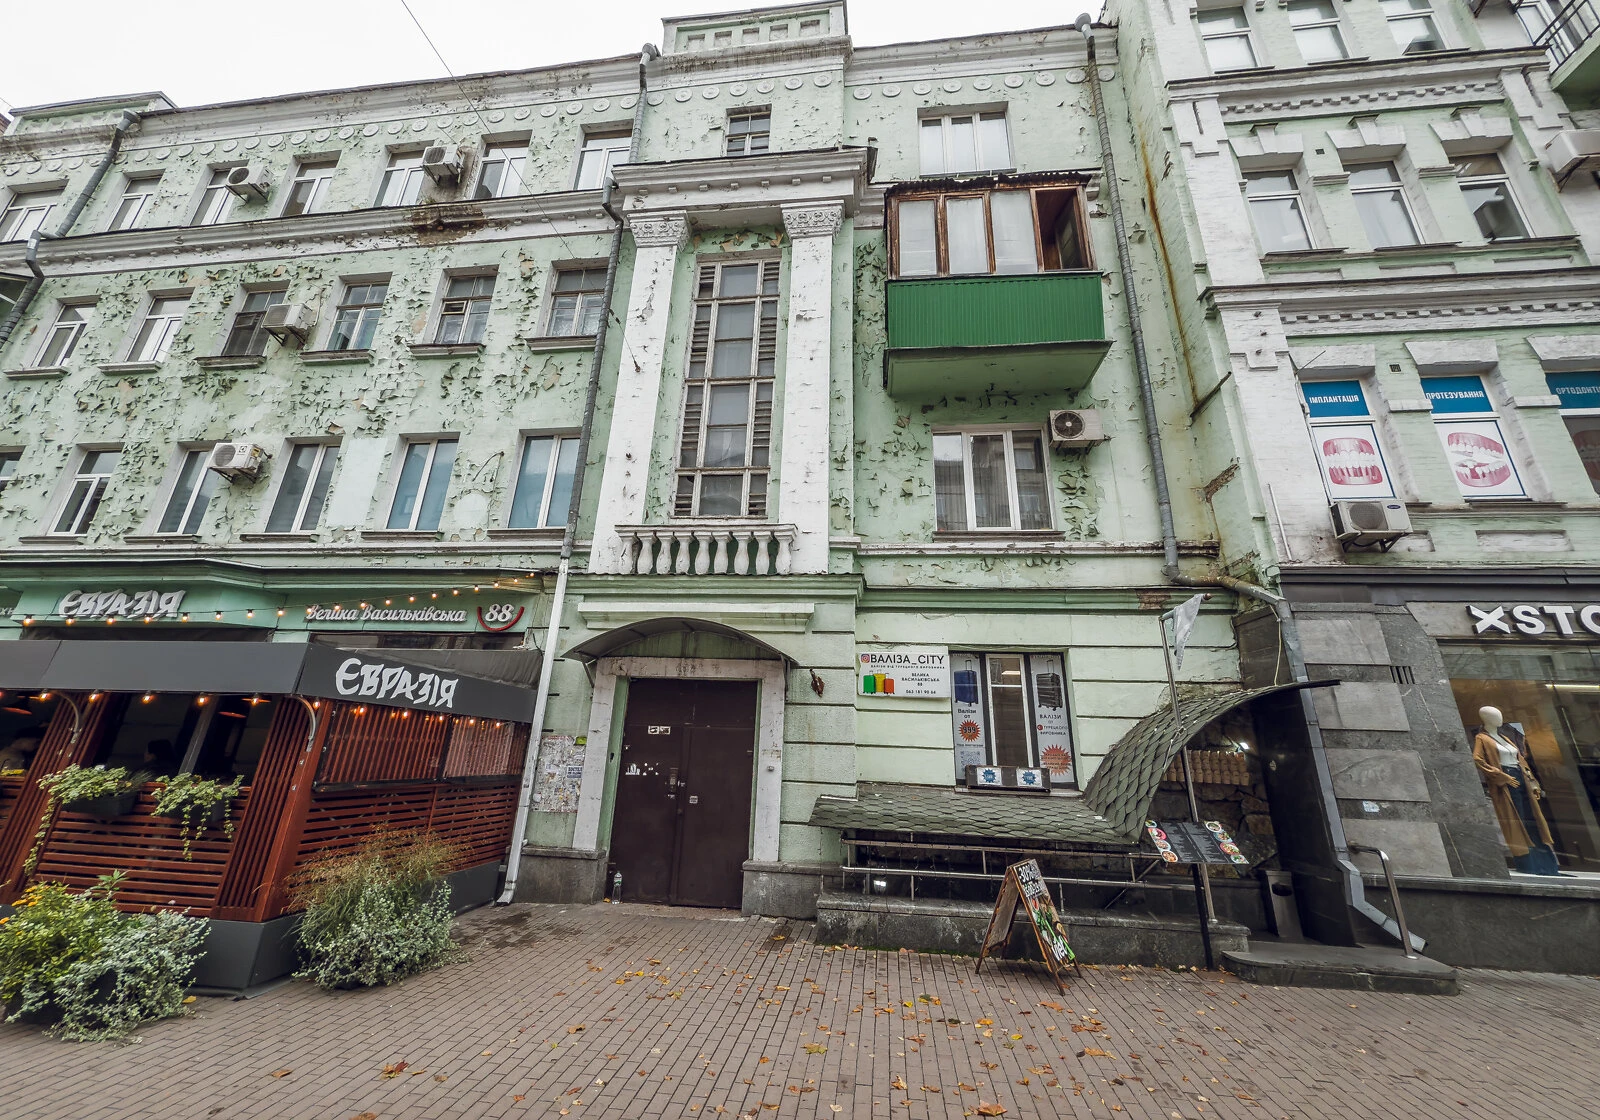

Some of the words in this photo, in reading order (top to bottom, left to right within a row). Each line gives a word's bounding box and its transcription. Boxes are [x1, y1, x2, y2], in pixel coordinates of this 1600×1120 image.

[1309, 395, 1359, 403] ІМПЛАНТАЦІЯ
[1425, 391, 1484, 399] ПРОТЕЗУВАННЯ
[59, 588, 187, 618] ЄВРАЗІЯ
[306, 604, 358, 621] Велика
[360, 604, 467, 622] Васильківська
[485, 603, 514, 622] 88
[335, 657, 459, 708] ЄВРАЗІЯ
[962, 726, 976, 734] 999
